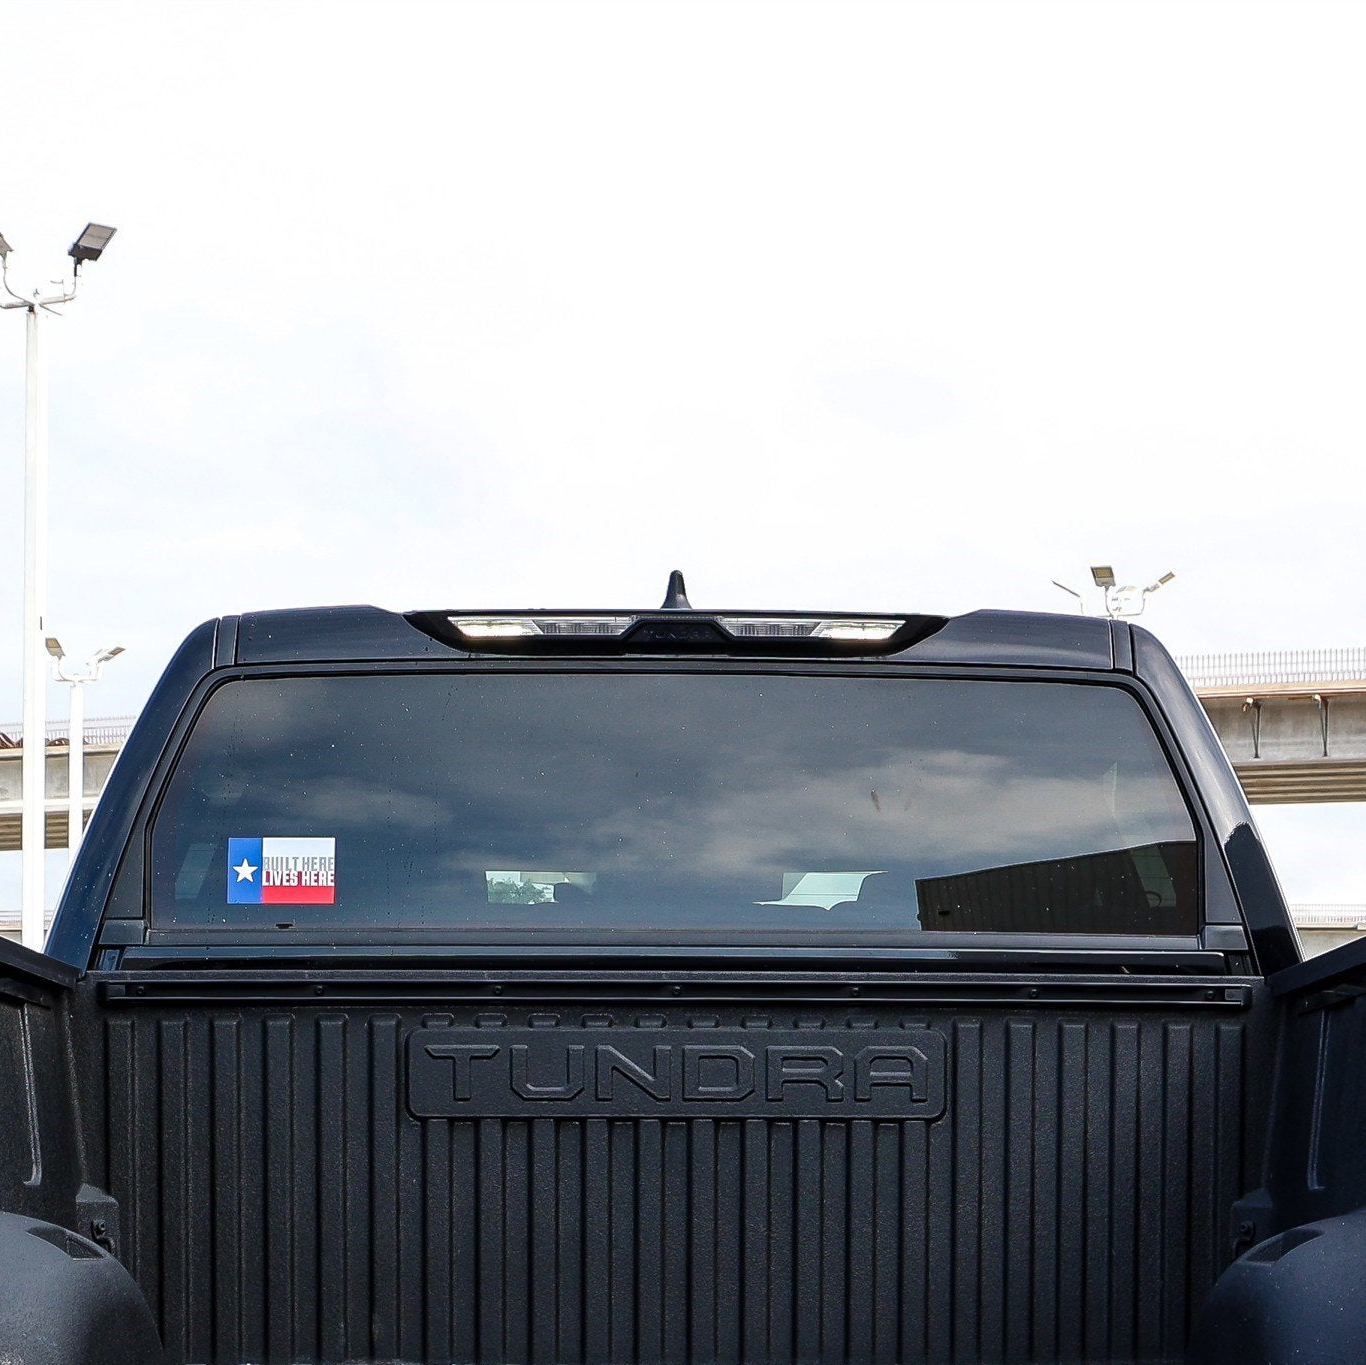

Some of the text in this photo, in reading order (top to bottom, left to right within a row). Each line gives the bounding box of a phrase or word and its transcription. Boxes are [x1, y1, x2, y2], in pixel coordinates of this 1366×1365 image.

[263, 856, 334, 871] BUILT HERE
[262, 871, 335, 886] LIVES HERE
[424, 1044, 928, 1102] TUNDRA
